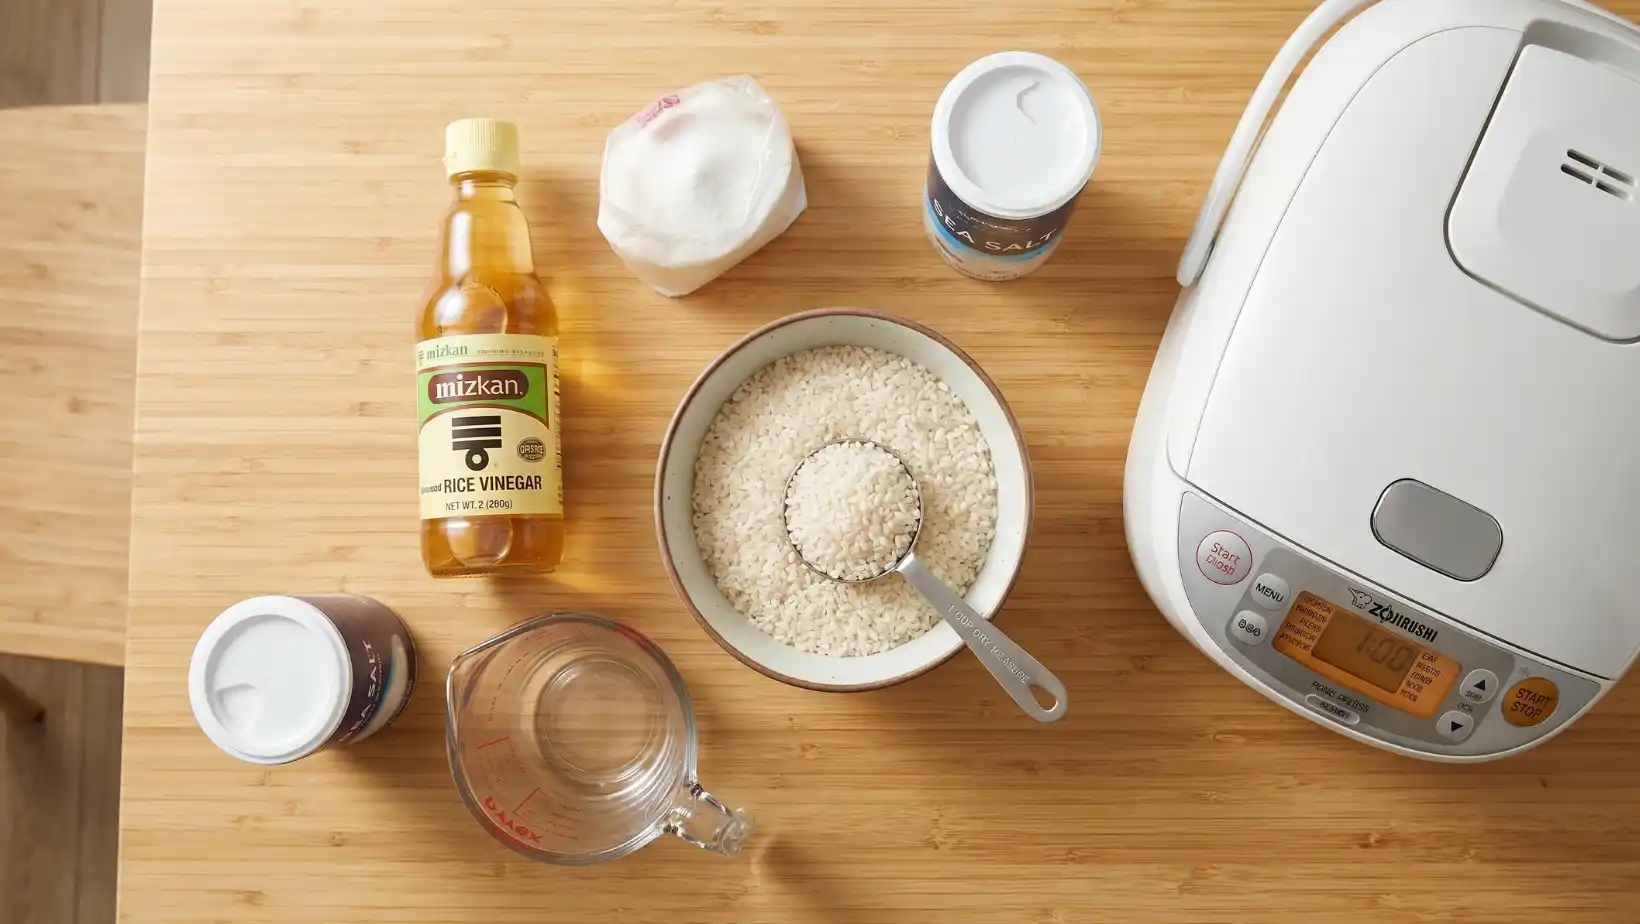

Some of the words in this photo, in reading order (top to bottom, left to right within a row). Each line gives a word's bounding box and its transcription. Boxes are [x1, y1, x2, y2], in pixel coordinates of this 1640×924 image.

[934, 198, 976, 245] SEA
[985, 227, 1057, 252] SALT
[426, 345, 468, 361] mizkan
[435, 374, 519, 399] mizkan
[444, 477, 475, 493] RICE
[479, 475, 542, 491] VINEGAR
[445, 501, 461, 511] NET
[478, 501, 484, 509] 2
[1210, 542, 1240, 564] Start
[1255, 583, 1284, 602] MENU
[1368, 602, 1438, 642] ZOJIRUSHI
[1356, 631, 1416, 671] 1:00
[1516, 688, 1555, 708] START
[1511, 701, 1543, 719] STOP
